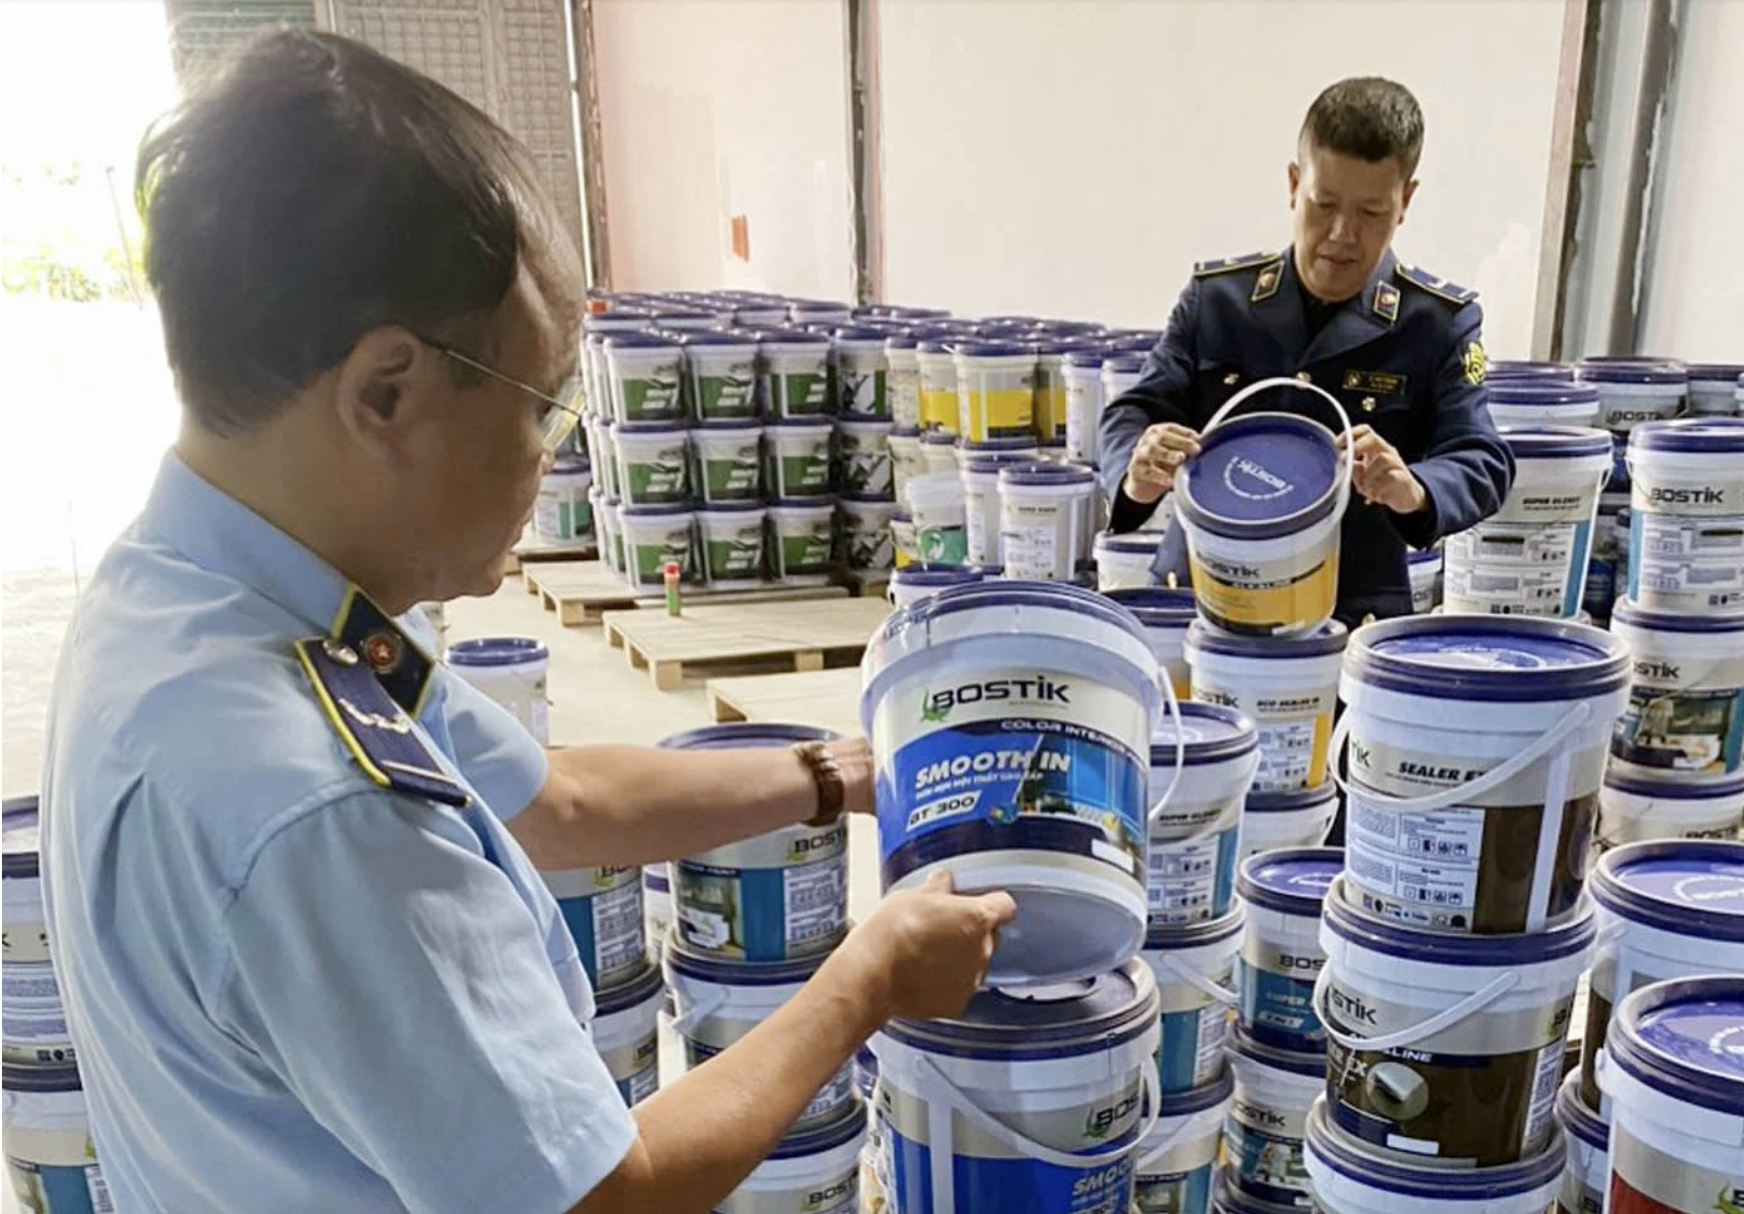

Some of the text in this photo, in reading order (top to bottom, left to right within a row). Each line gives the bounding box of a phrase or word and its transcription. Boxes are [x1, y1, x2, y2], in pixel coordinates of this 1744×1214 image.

[915, 751, 1071, 790] SMOOTH IN
[1398, 761, 1461, 781] SEALER
[935, 795, 976, 815] 300
